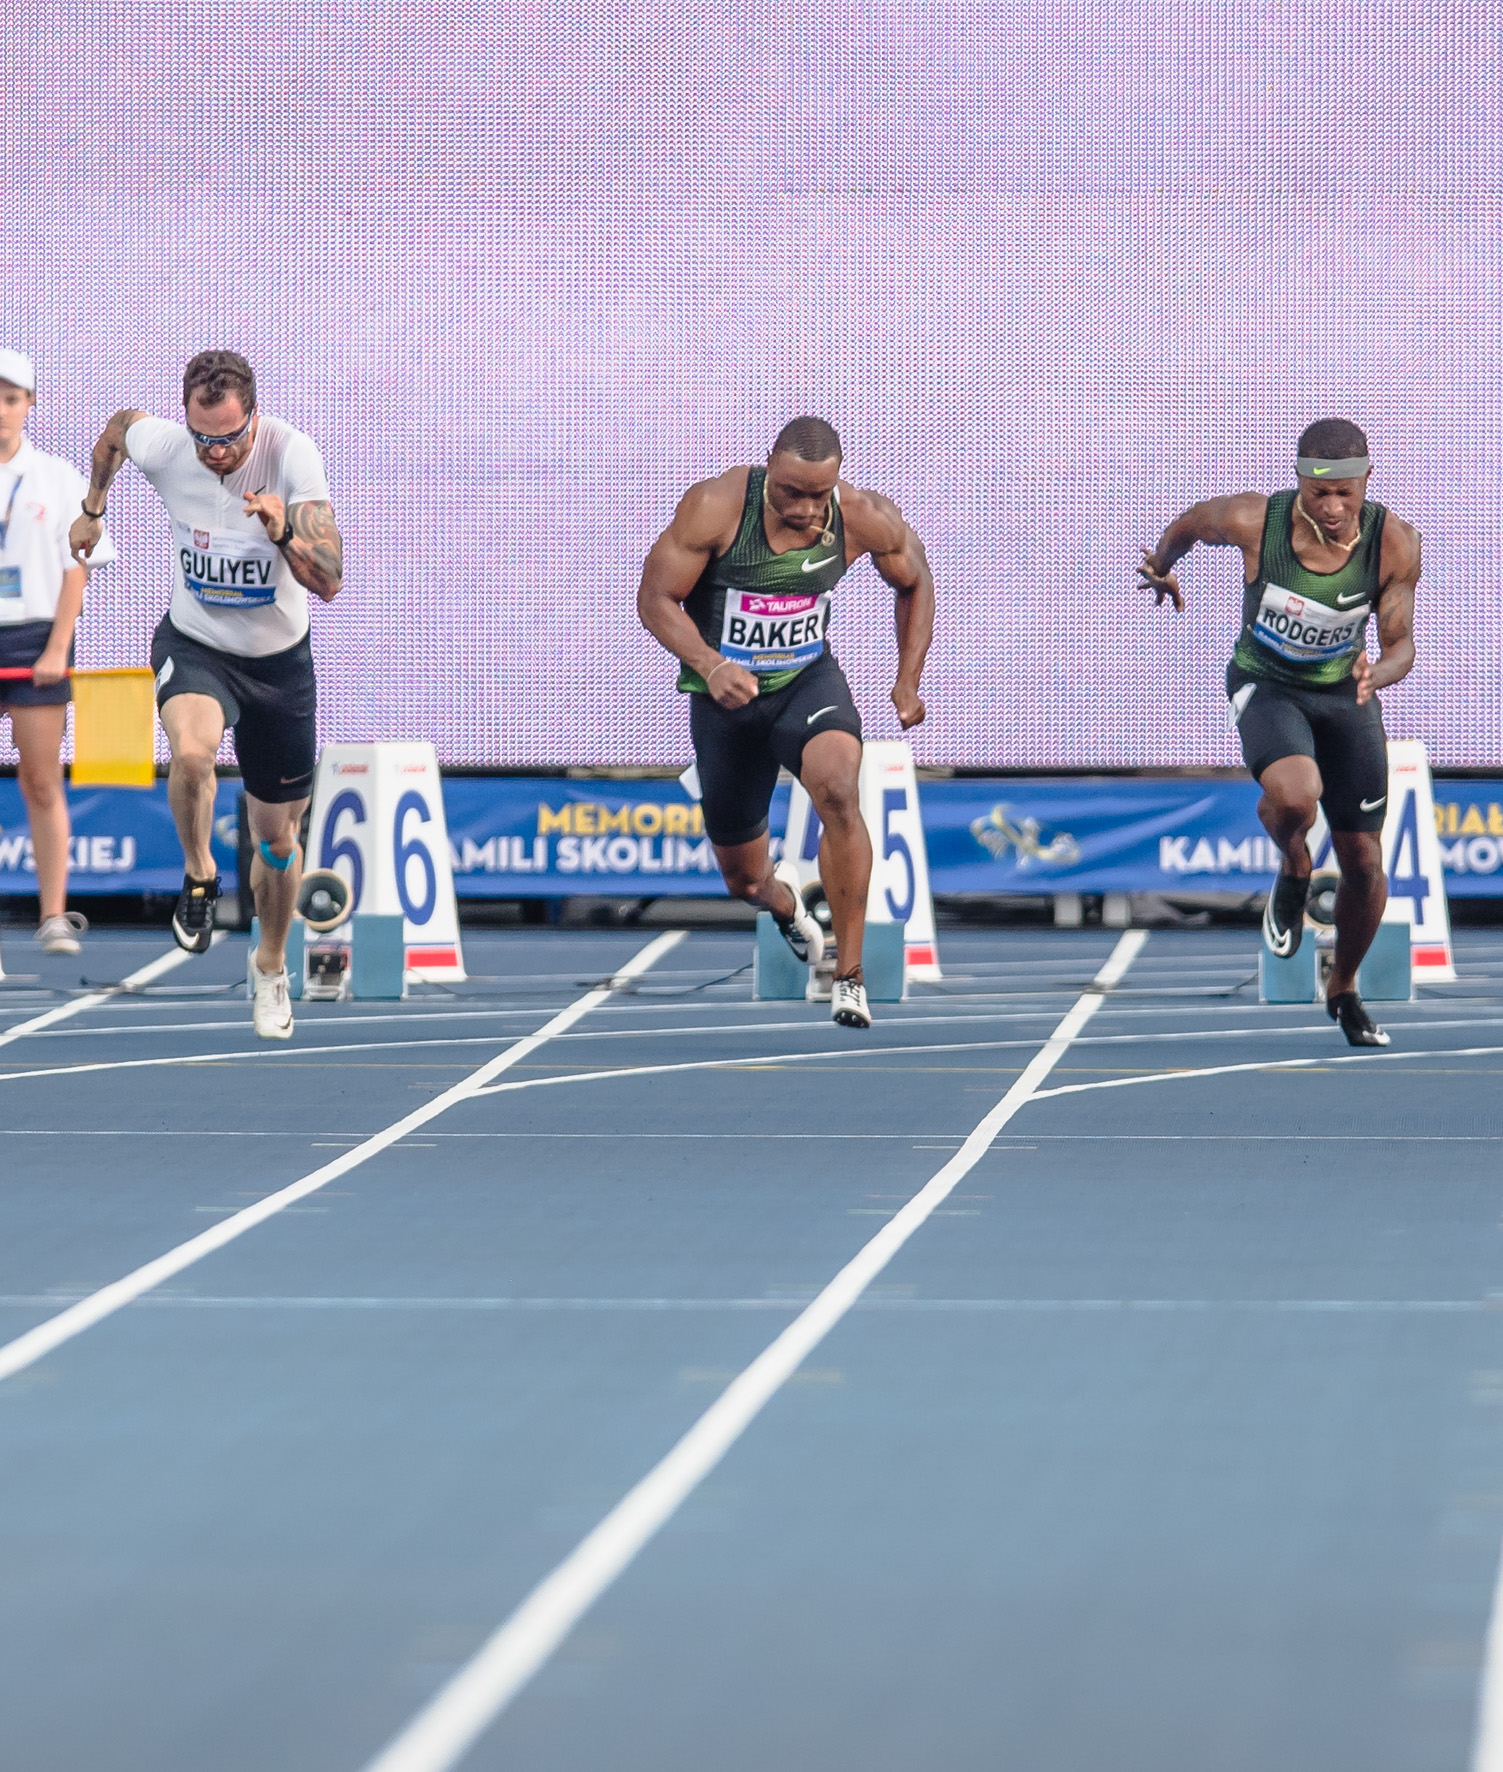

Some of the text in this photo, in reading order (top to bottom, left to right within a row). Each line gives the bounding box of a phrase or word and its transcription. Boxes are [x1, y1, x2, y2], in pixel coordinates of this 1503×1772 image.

[180, 548, 271, 585] GULIYEV
[728, 614, 819, 647] BAKER
[1263, 608, 1355, 646] RODGERS
[394, 791, 436, 926] 6
[883, 788, 915, 921] 5
[1159, 836, 1282, 873] KAMIL
[1387, 788, 1430, 925] 4
